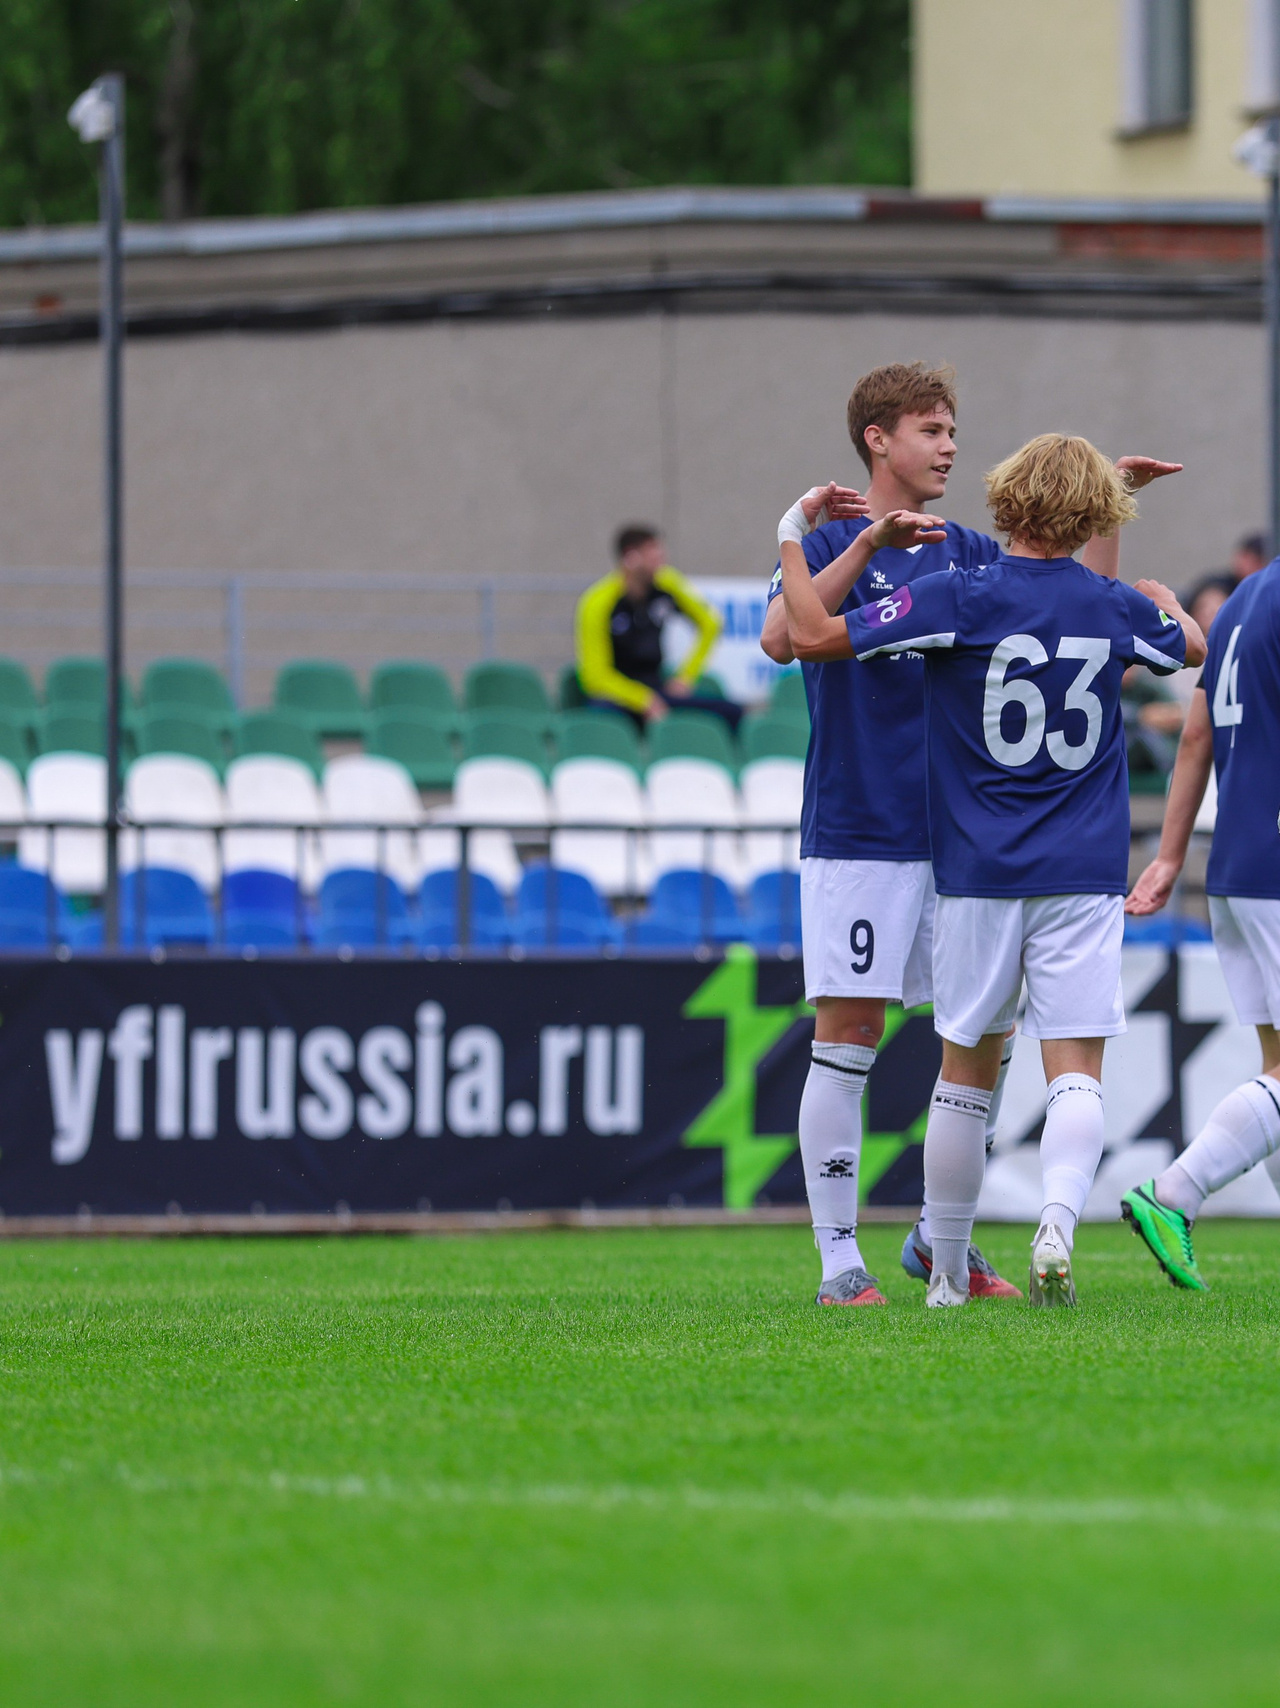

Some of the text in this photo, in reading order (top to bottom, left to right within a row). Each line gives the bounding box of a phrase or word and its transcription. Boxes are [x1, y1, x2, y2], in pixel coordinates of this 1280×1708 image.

[870, 582, 894, 590] KELME
[983, 634, 1111, 771] 63
[1213, 624, 1243, 748] 4
[850, 919, 875, 974] 9
[44, 1000, 645, 1165] yflrussia.ru
